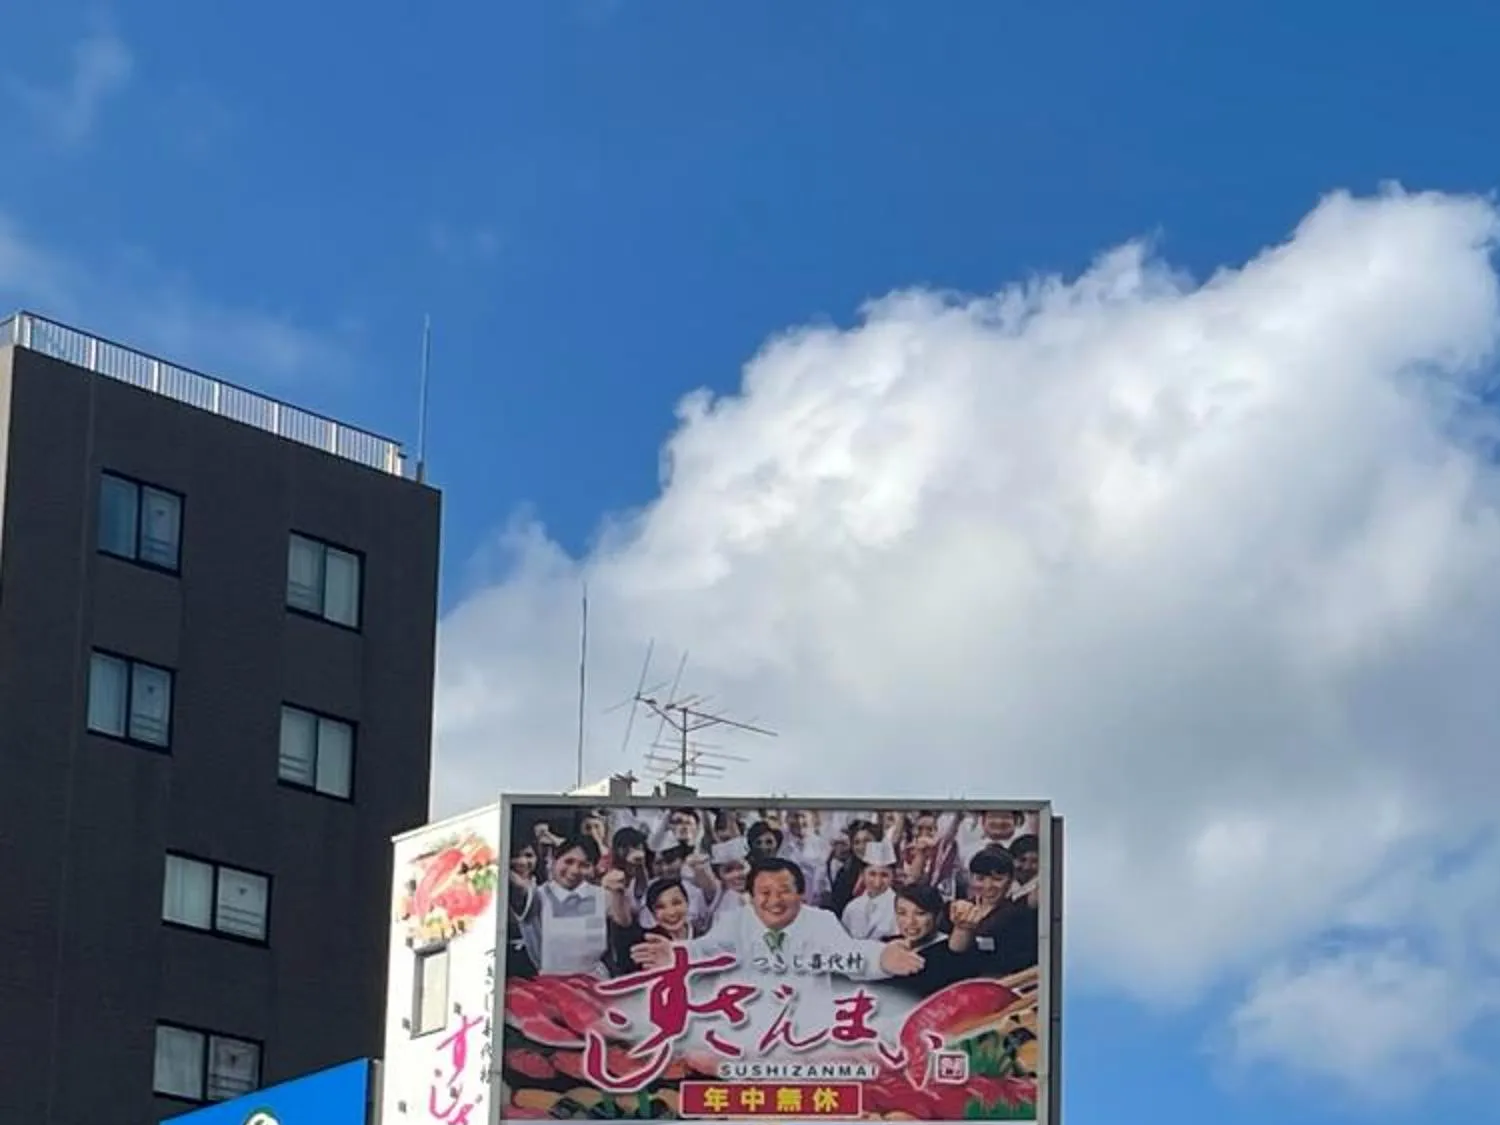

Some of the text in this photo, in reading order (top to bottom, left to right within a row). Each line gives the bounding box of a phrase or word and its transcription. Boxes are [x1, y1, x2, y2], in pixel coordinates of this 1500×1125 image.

[752, 951, 866, 973] つきじ喜代村
[719, 1063, 880, 1079] SUSHIZANMAI
[703, 1087, 841, 1113] 年中無休
